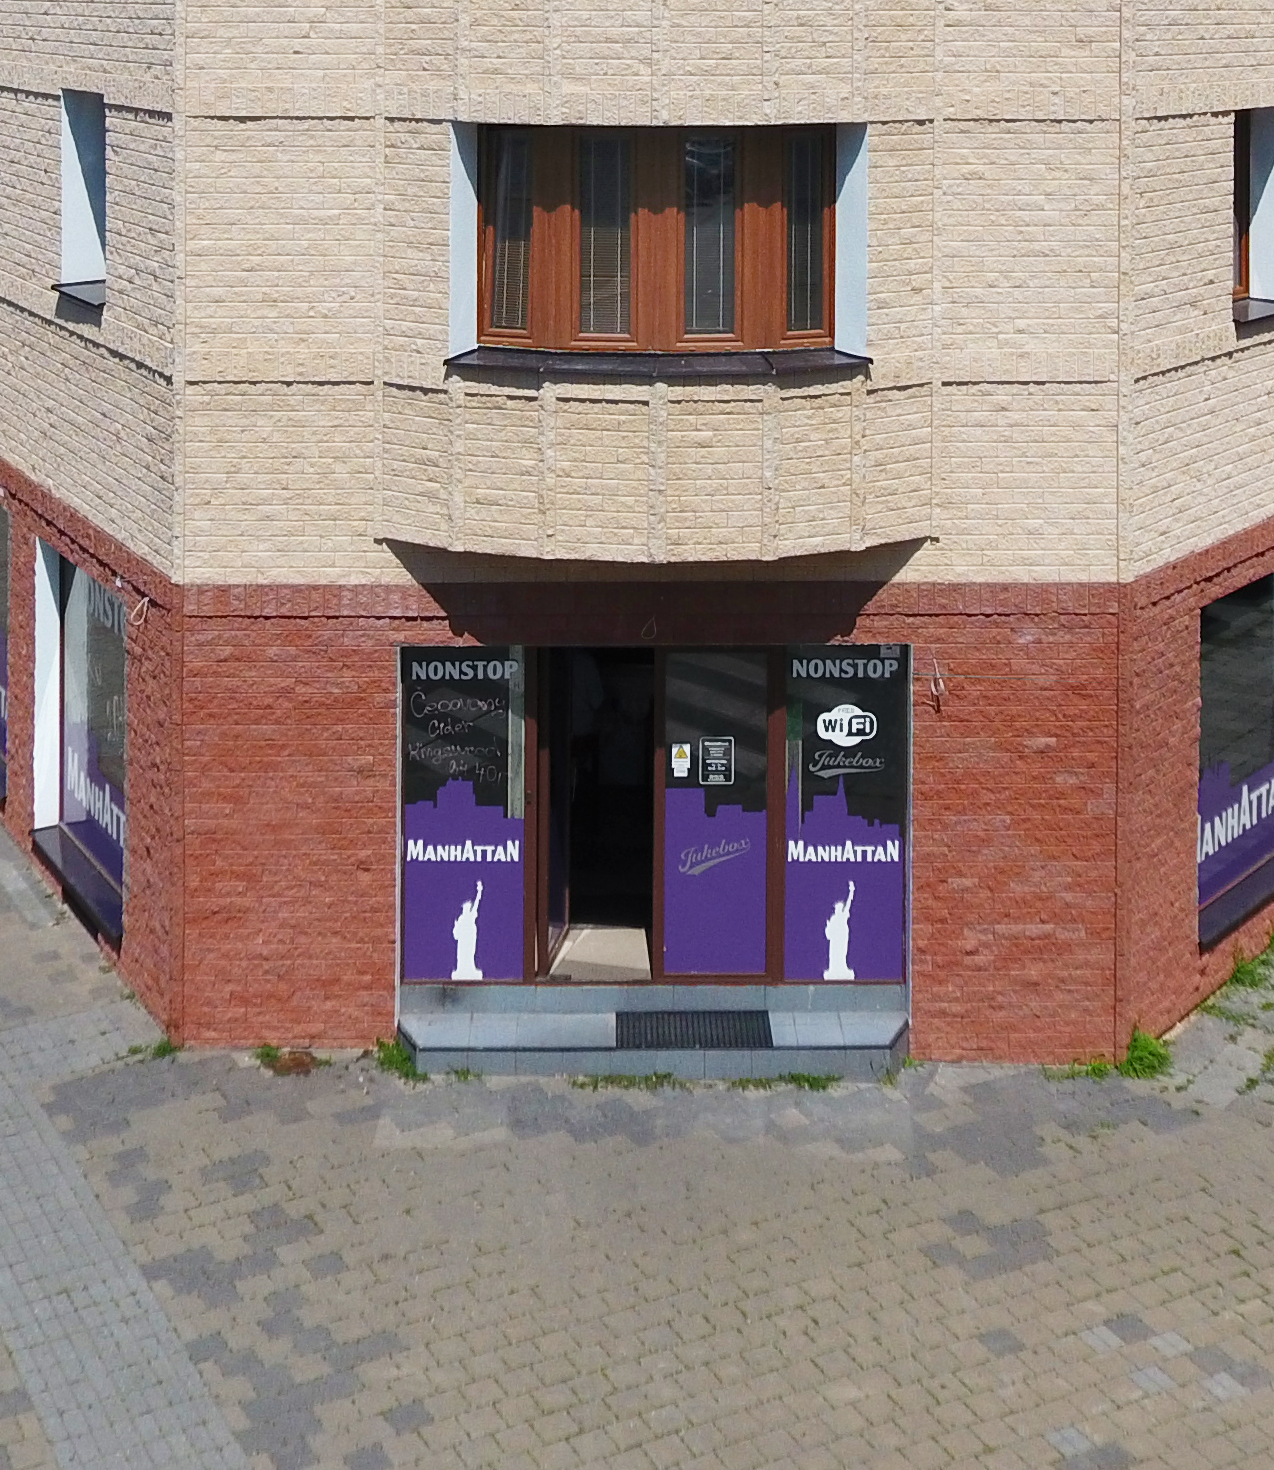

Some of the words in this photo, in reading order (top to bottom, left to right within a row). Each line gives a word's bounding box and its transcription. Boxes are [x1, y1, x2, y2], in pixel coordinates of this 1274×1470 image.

[411, 660, 519, 680] NONSTOP
[792, 658, 899, 678] NONSTOP
[428, 718, 474, 738] Cider
[809, 750, 885, 772] Jukebox
[67, 746, 126, 847] MANHATT
[406, 839, 520, 862] MANHATTAN
[678, 838, 751, 873] Jukebox
[787, 840, 900, 862] MANHATTAN
